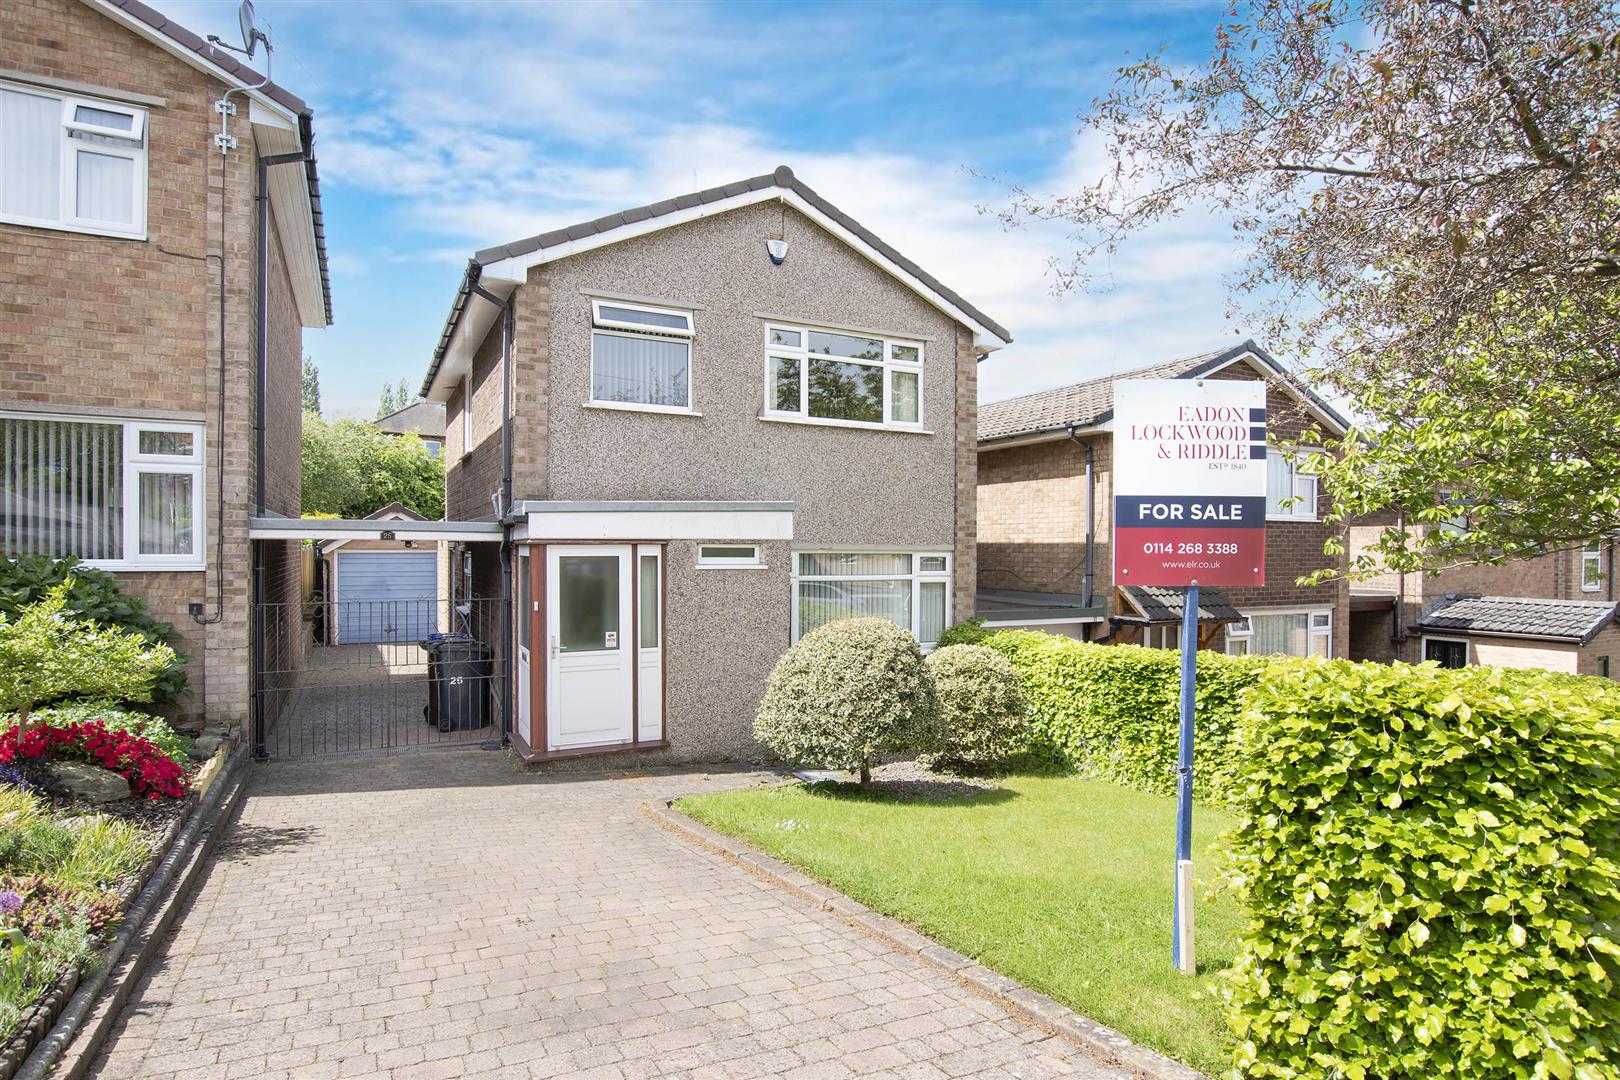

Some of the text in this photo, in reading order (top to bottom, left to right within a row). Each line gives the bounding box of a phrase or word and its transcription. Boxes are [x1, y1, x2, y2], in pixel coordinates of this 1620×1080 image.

[1178, 406, 1245, 422] EADON
[1131, 425, 1247, 441] LOCKWOOD
[1157, 443, 1247, 460] & RIDDLE
[1139, 503, 1243, 520] FOR SALE
[1143, 542, 1238, 554] 0114 268 3388
[1162, 560, 1221, 569] www.elr.co.uk
[450, 676, 463, 685] 25
